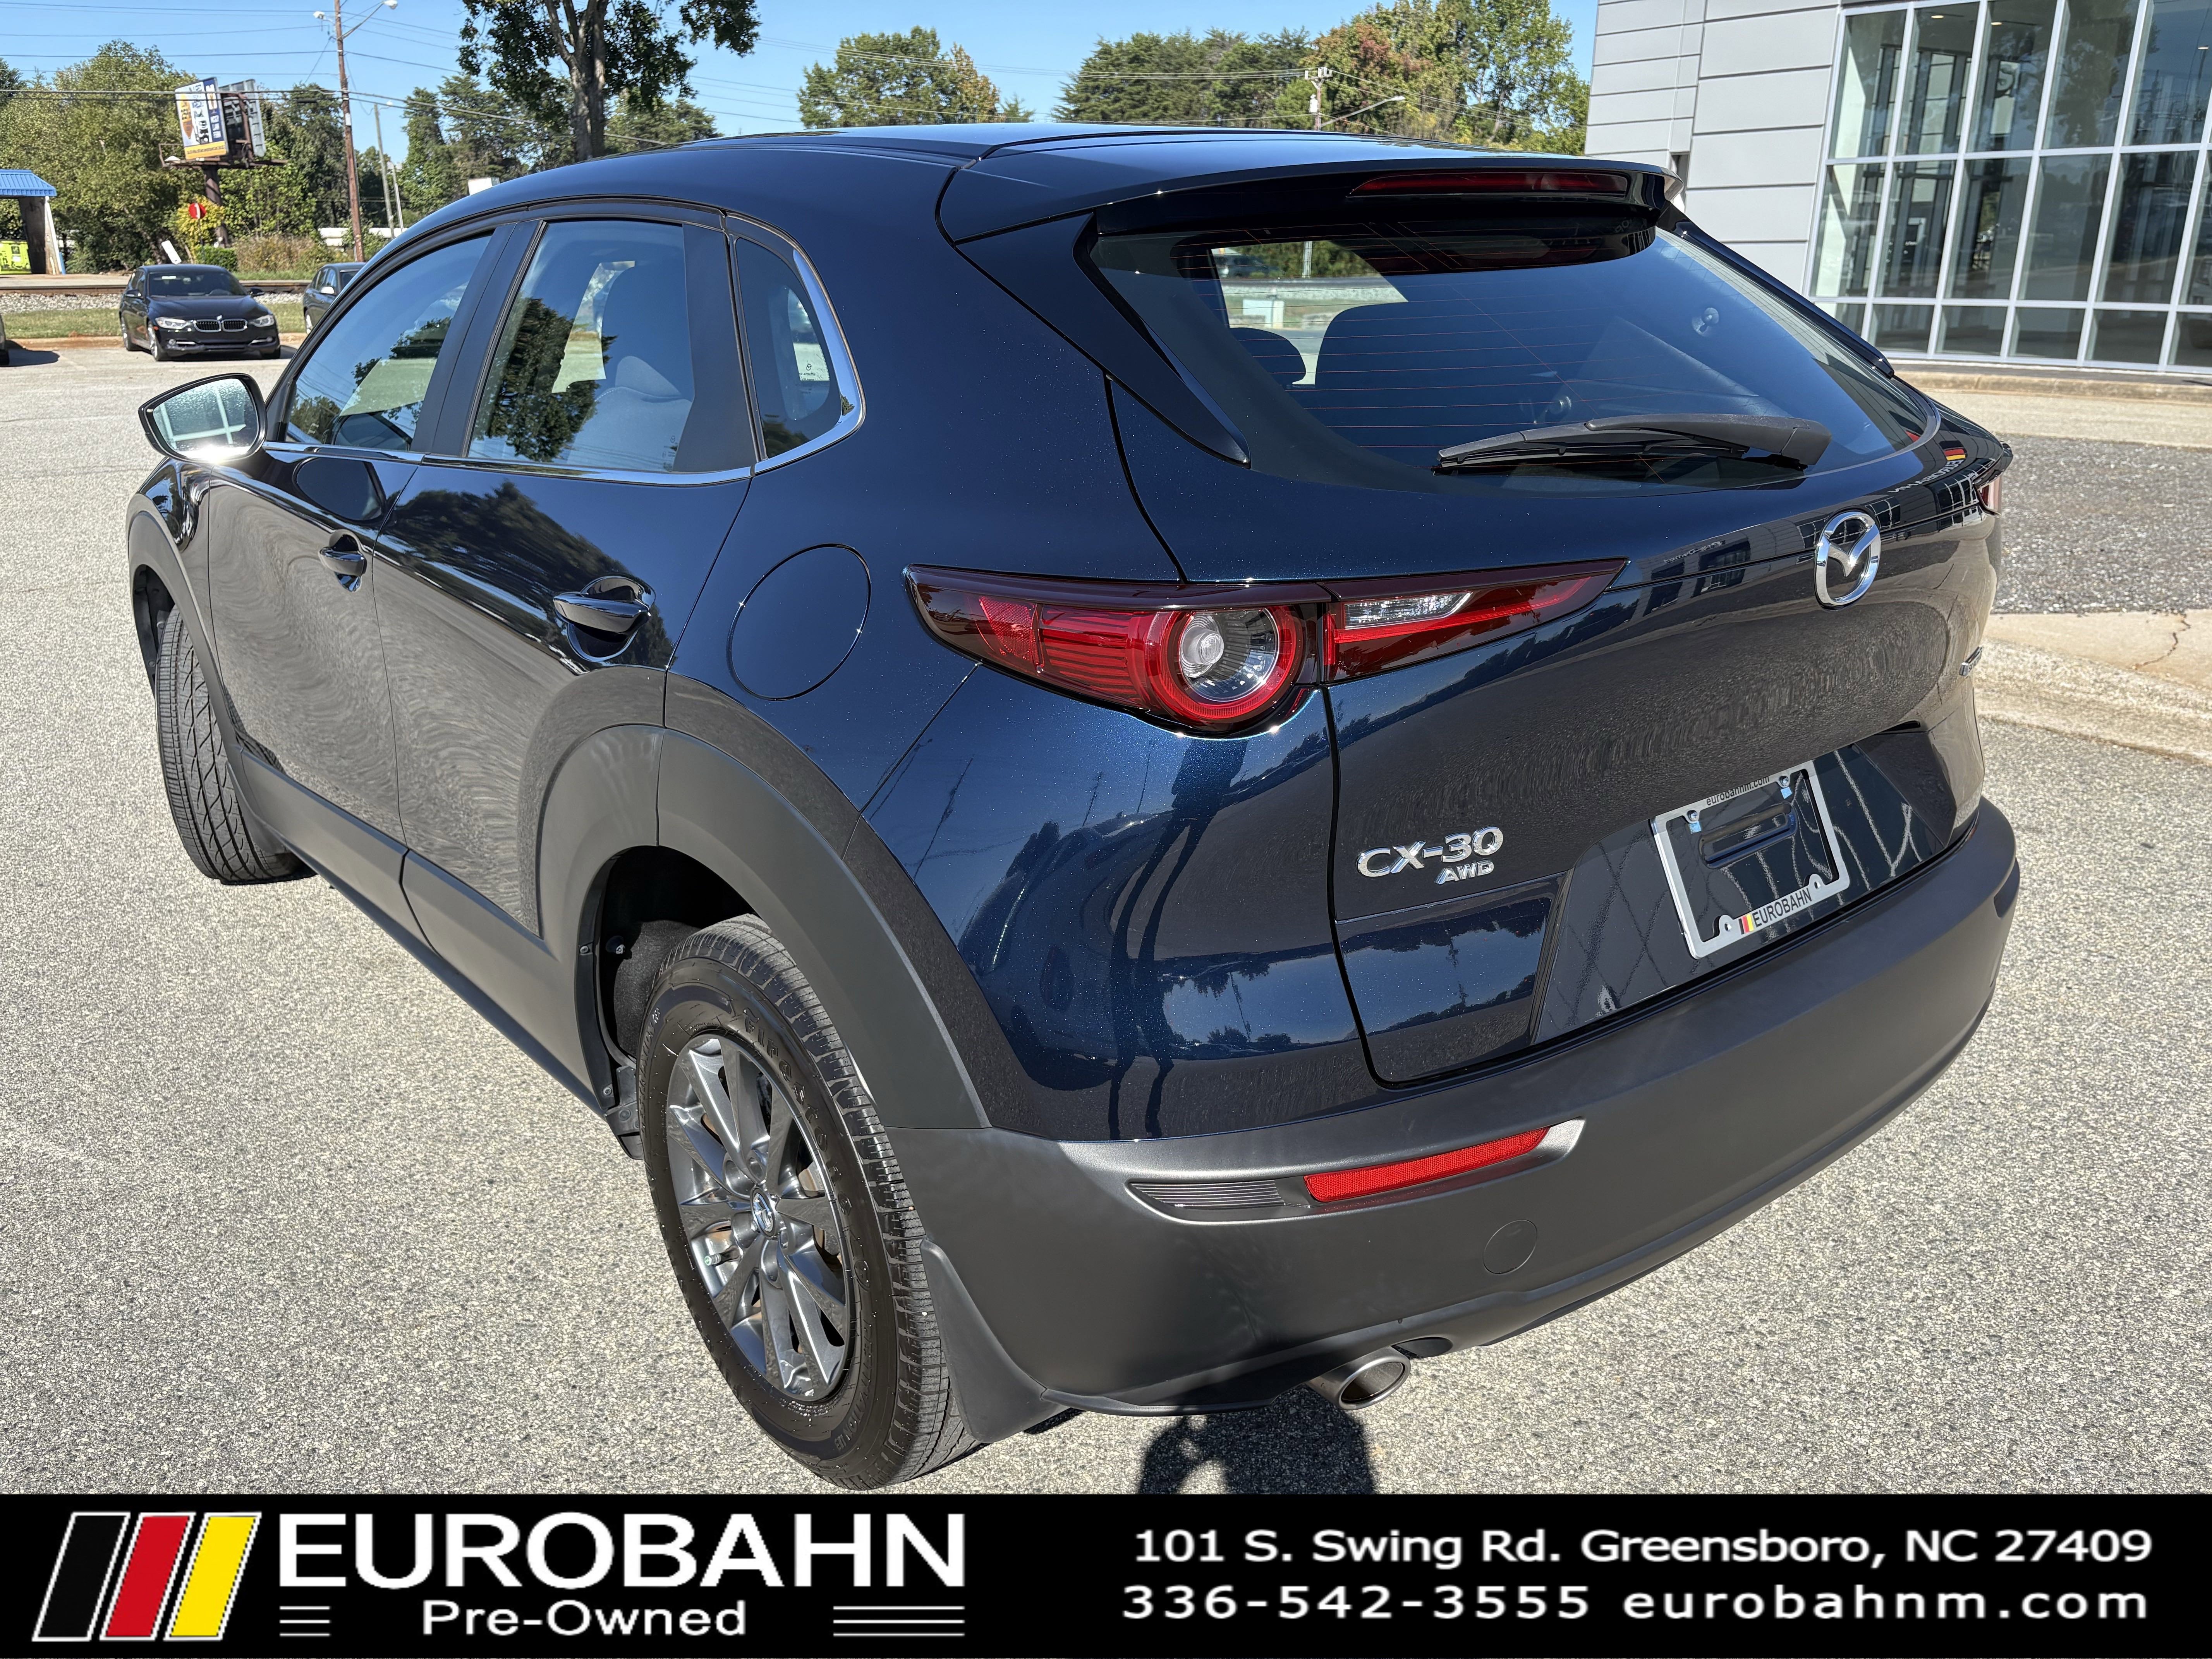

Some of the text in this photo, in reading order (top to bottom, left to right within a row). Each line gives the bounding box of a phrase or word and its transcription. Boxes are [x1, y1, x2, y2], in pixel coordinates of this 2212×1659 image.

[1707, 776, 1770, 805] eurobahnm.com
[1356, 826, 1503, 877] CX-30
[1434, 859, 1494, 885] AWD
[1752, 888, 1812, 927] EUROBAHN
[743, 1007, 853, 1216] Firestone
